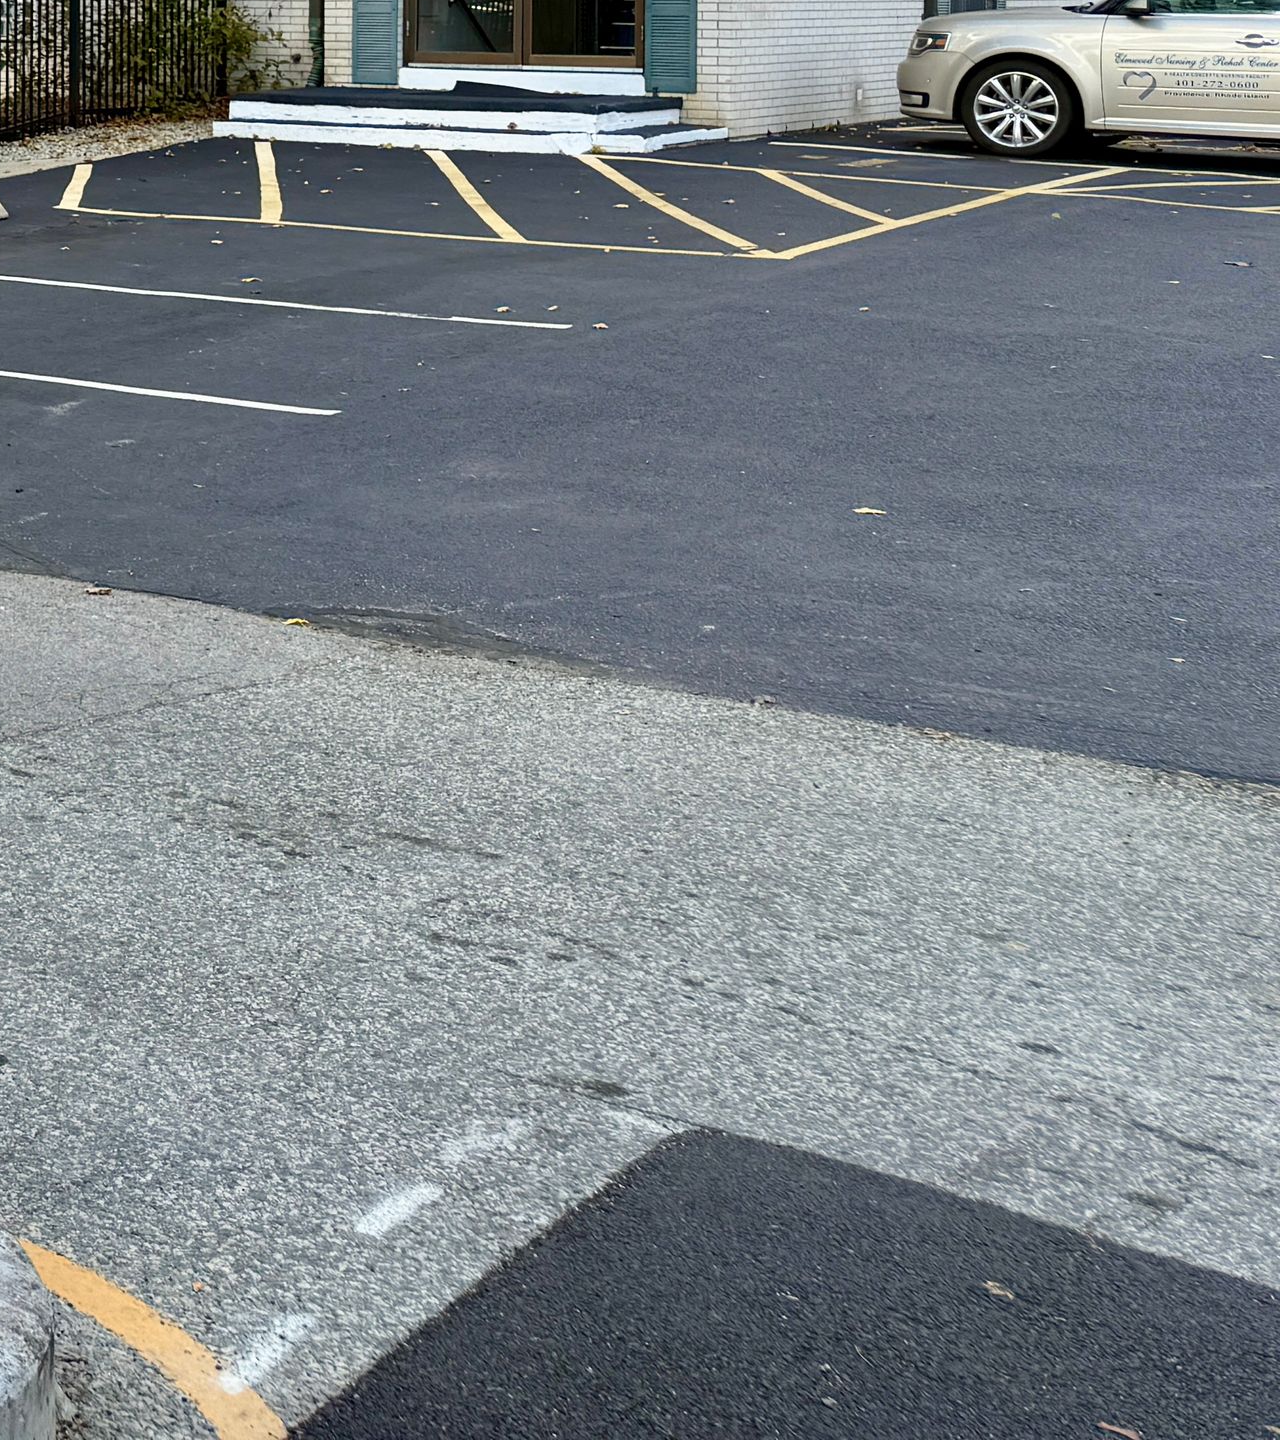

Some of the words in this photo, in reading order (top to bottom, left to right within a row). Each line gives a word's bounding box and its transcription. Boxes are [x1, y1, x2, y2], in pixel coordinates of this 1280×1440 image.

[1114, 51, 1155, 65] Elmwood
[1155, 53, 1197, 68] Nursing
[1212, 54, 1244, 67] Rehab
[1247, 55, 1279, 68] Center
[1174, 79, 1259, 89] 401-272-0600
